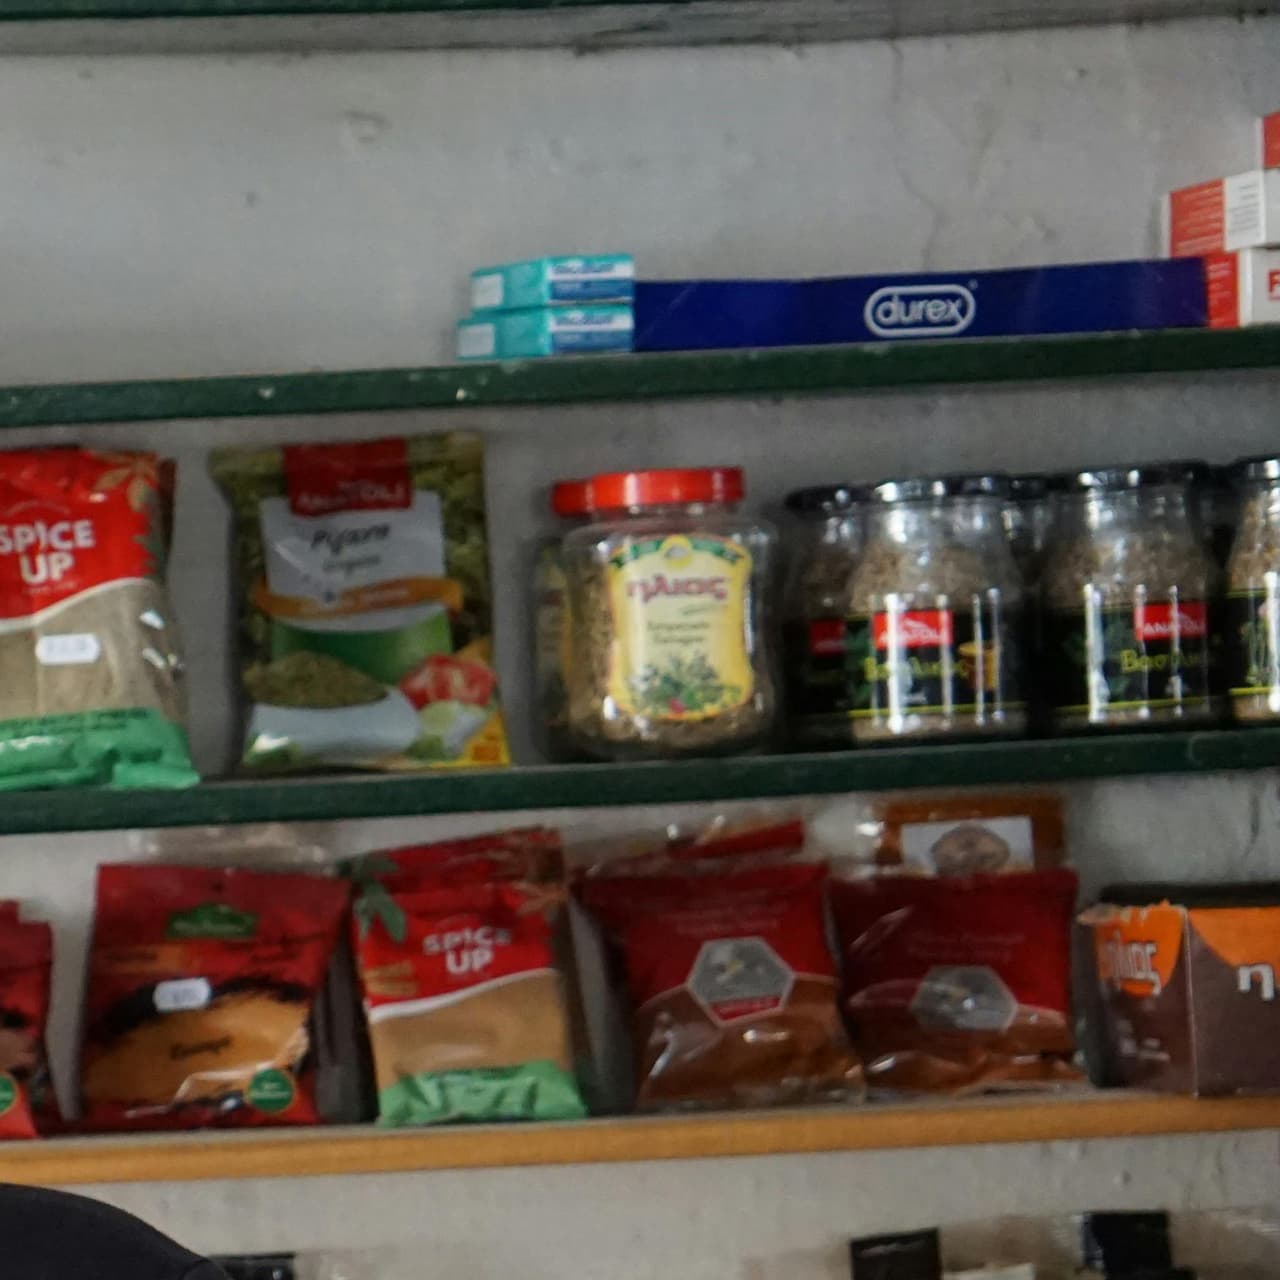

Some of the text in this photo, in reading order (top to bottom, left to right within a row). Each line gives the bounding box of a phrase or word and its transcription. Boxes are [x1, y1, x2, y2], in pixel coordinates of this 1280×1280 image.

[875, 293, 964, 325] durex
[20, 551, 75, 584] UP
[423, 926, 513, 954] SPICE
[445, 948, 495, 975] UP
